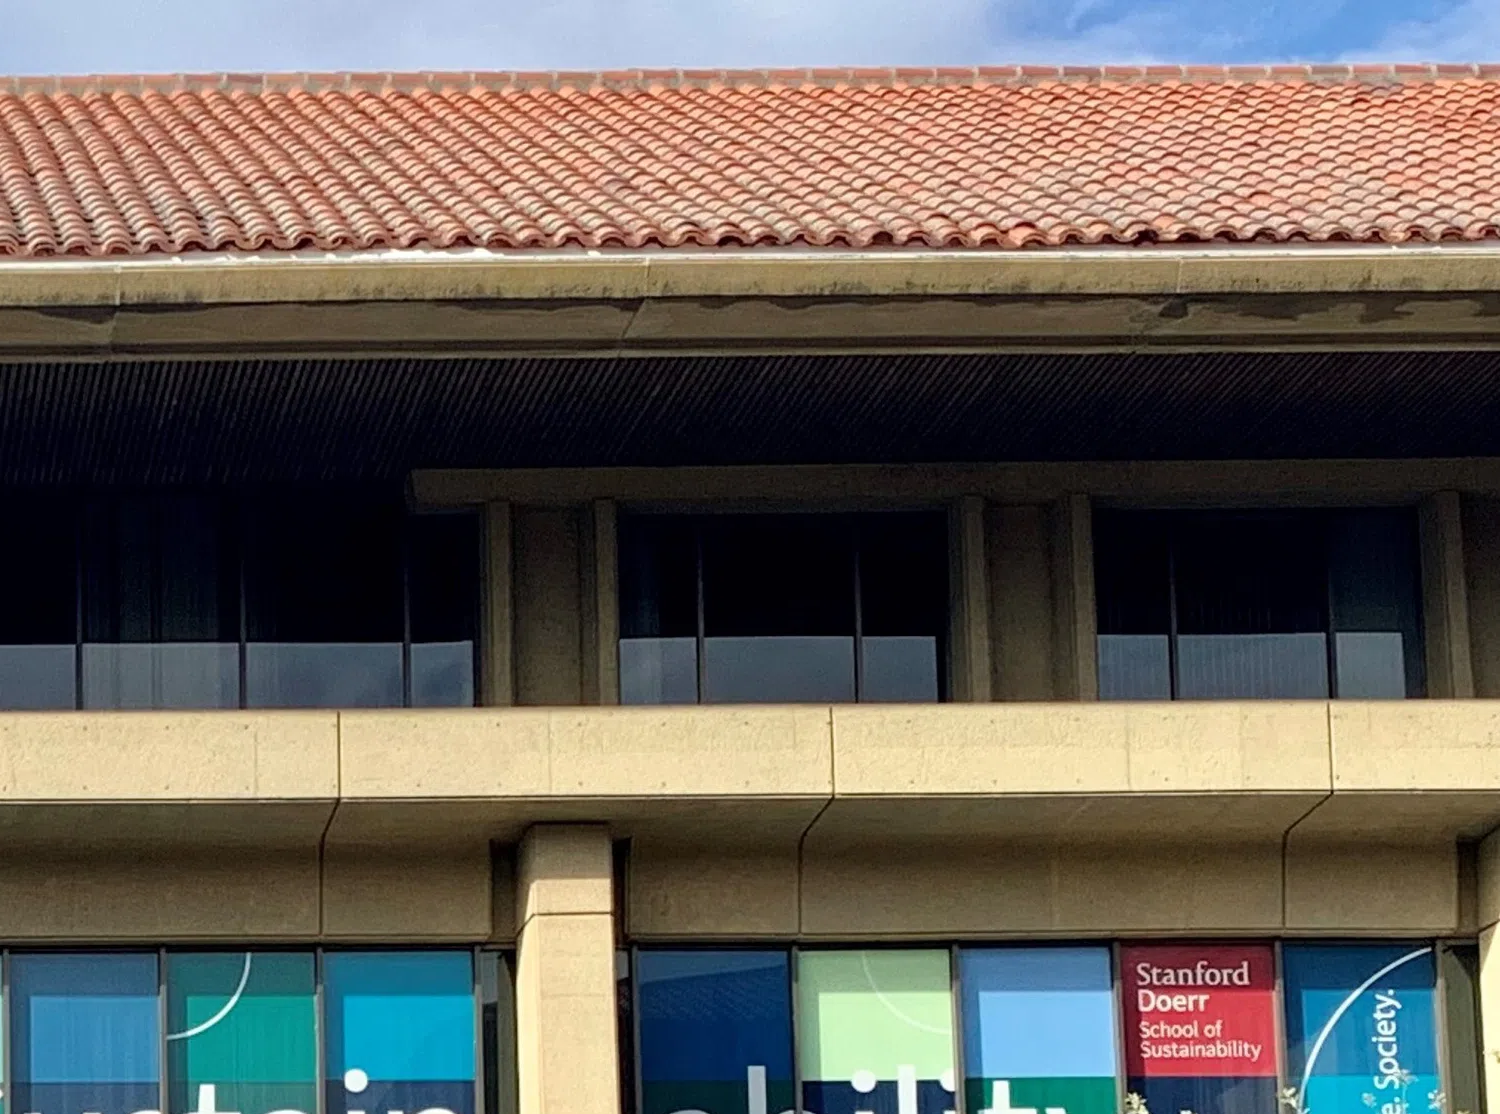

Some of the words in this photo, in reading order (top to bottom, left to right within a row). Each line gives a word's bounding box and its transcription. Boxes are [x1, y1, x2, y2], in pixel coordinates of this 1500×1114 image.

[1136, 961, 1250, 986] Stanford
[1138, 989, 1210, 1012] Doerr
[1140, 1020, 1199, 1038] School
[1202, 1019, 1223, 1038] of
[1372, 988, 1403, 1090] Society.
[1140, 1040, 1262, 1062] Sustainability
